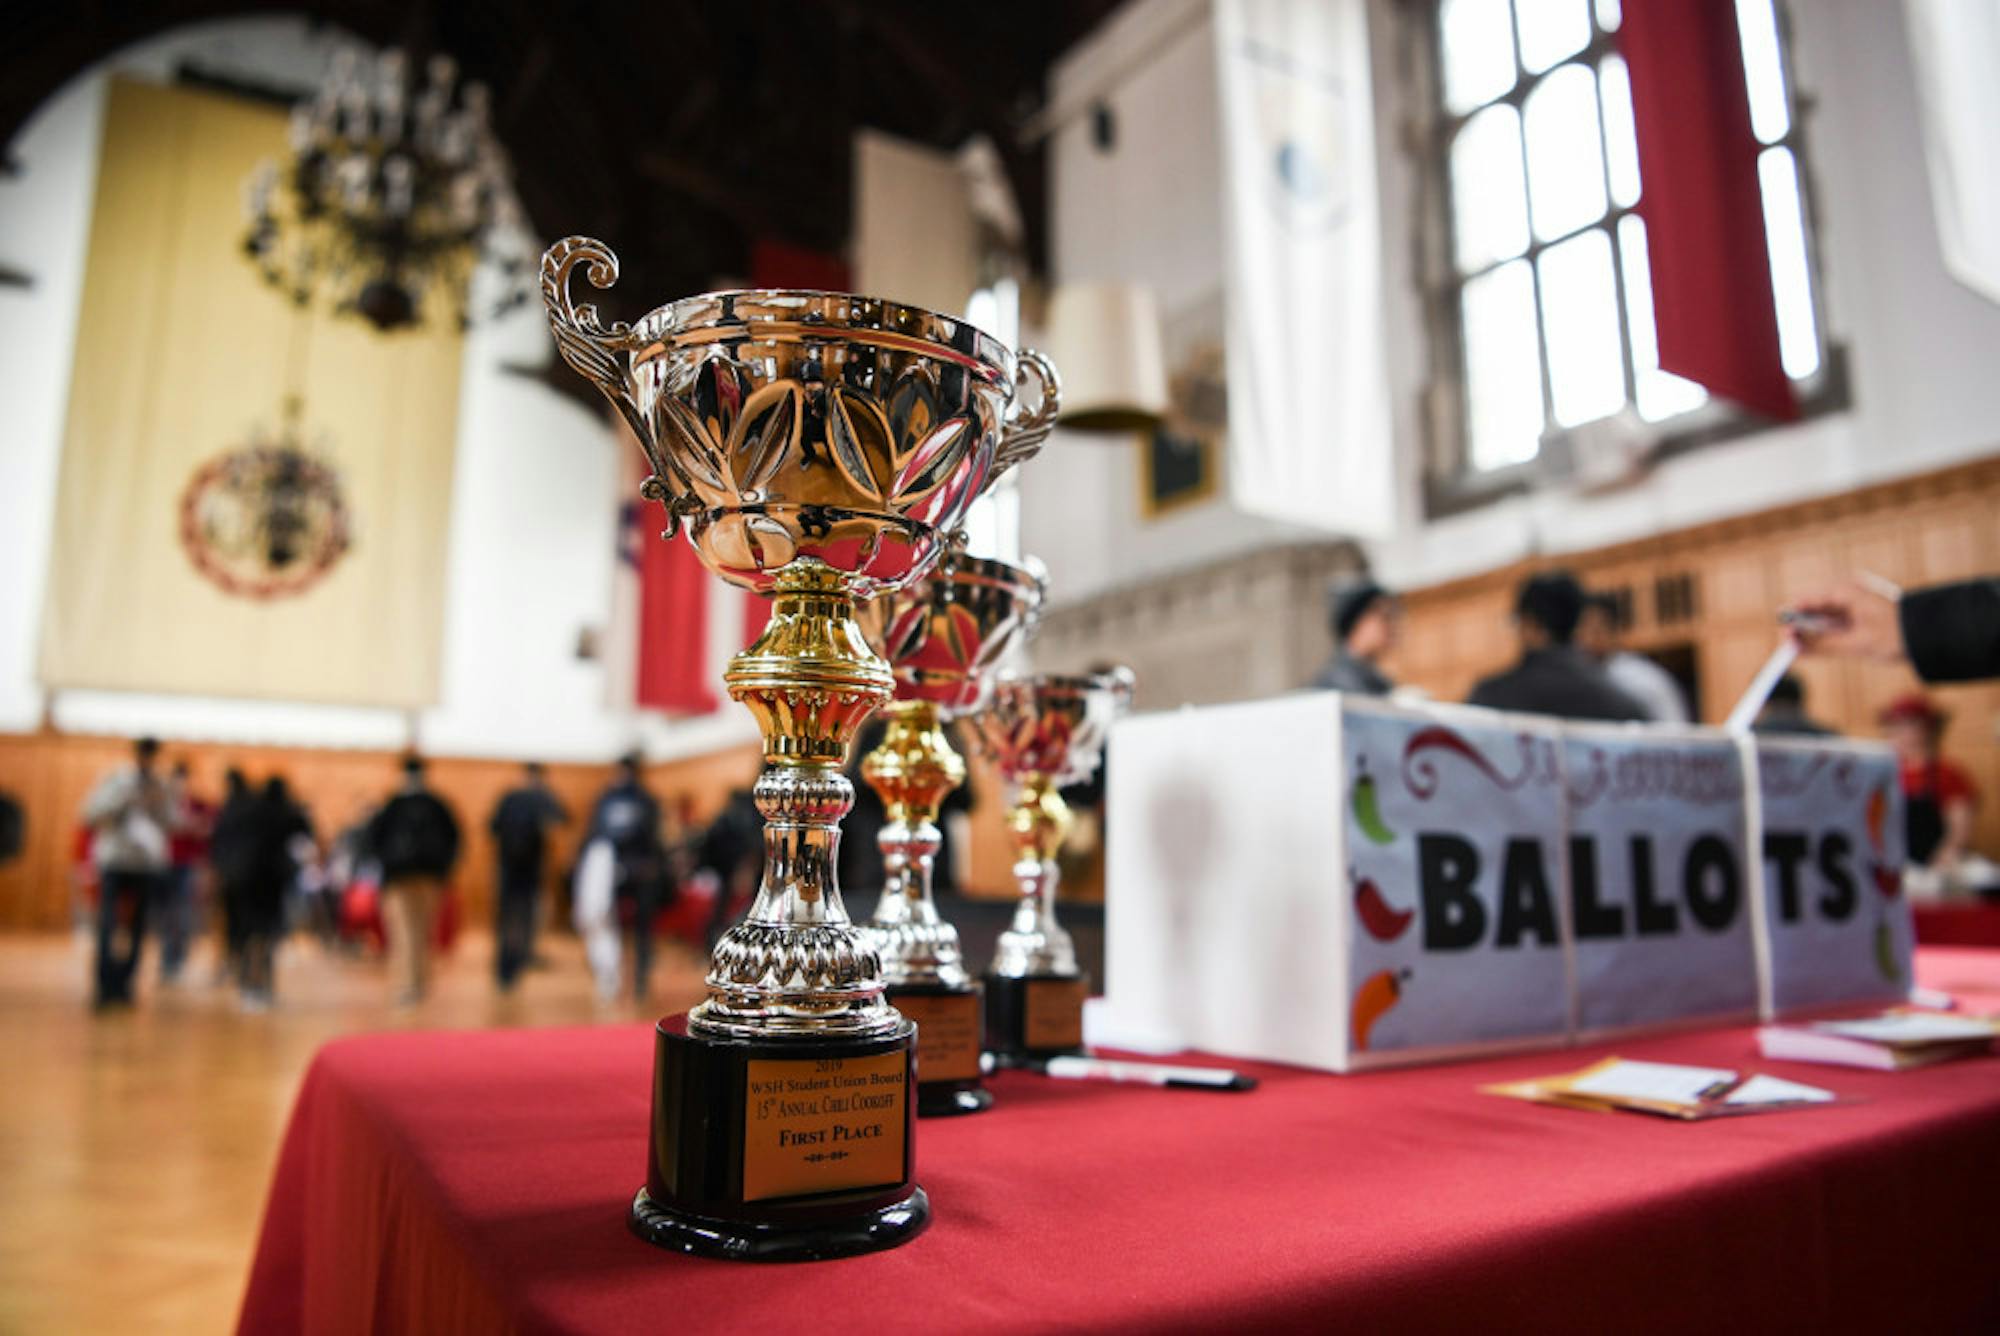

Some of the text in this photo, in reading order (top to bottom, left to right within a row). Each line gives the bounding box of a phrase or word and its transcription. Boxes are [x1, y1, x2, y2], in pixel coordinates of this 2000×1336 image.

[1417, 830, 1857, 952] BALLOTS
[815, 1059, 842, 1073] 2019
[752, 1071, 902, 1094] WSH Student Union Board
[779, 1123, 883, 1147] FIRST PLACE
